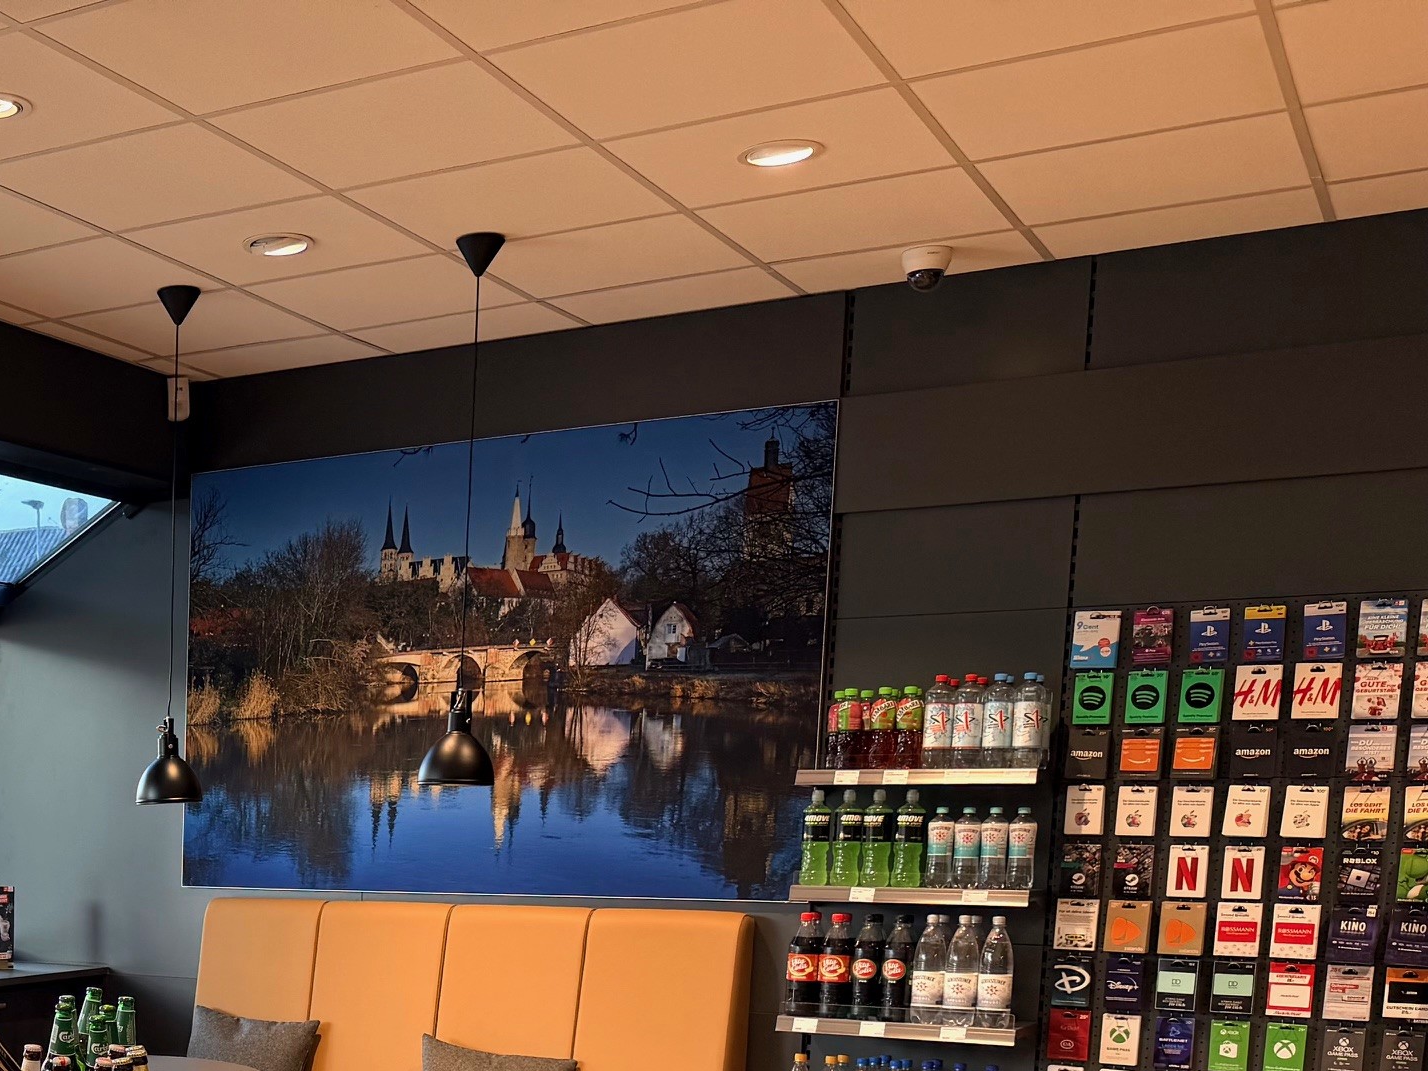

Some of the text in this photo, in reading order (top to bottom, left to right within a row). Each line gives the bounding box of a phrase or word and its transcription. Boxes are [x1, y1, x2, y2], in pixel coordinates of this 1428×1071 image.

[1077, 621, 1083, 630] 9
[1233, 678, 1282, 708] H&M
[1292, 676, 1342, 706] H&M
[1070, 750, 1103, 758] amazon
[1235, 748, 1271, 756] amazon
[1293, 747, 1330, 755] amazon
[1340, 920, 1367, 931] KINO
[1400, 922, 1428, 933] KINO
[1106, 976, 1139, 993] Disney+
